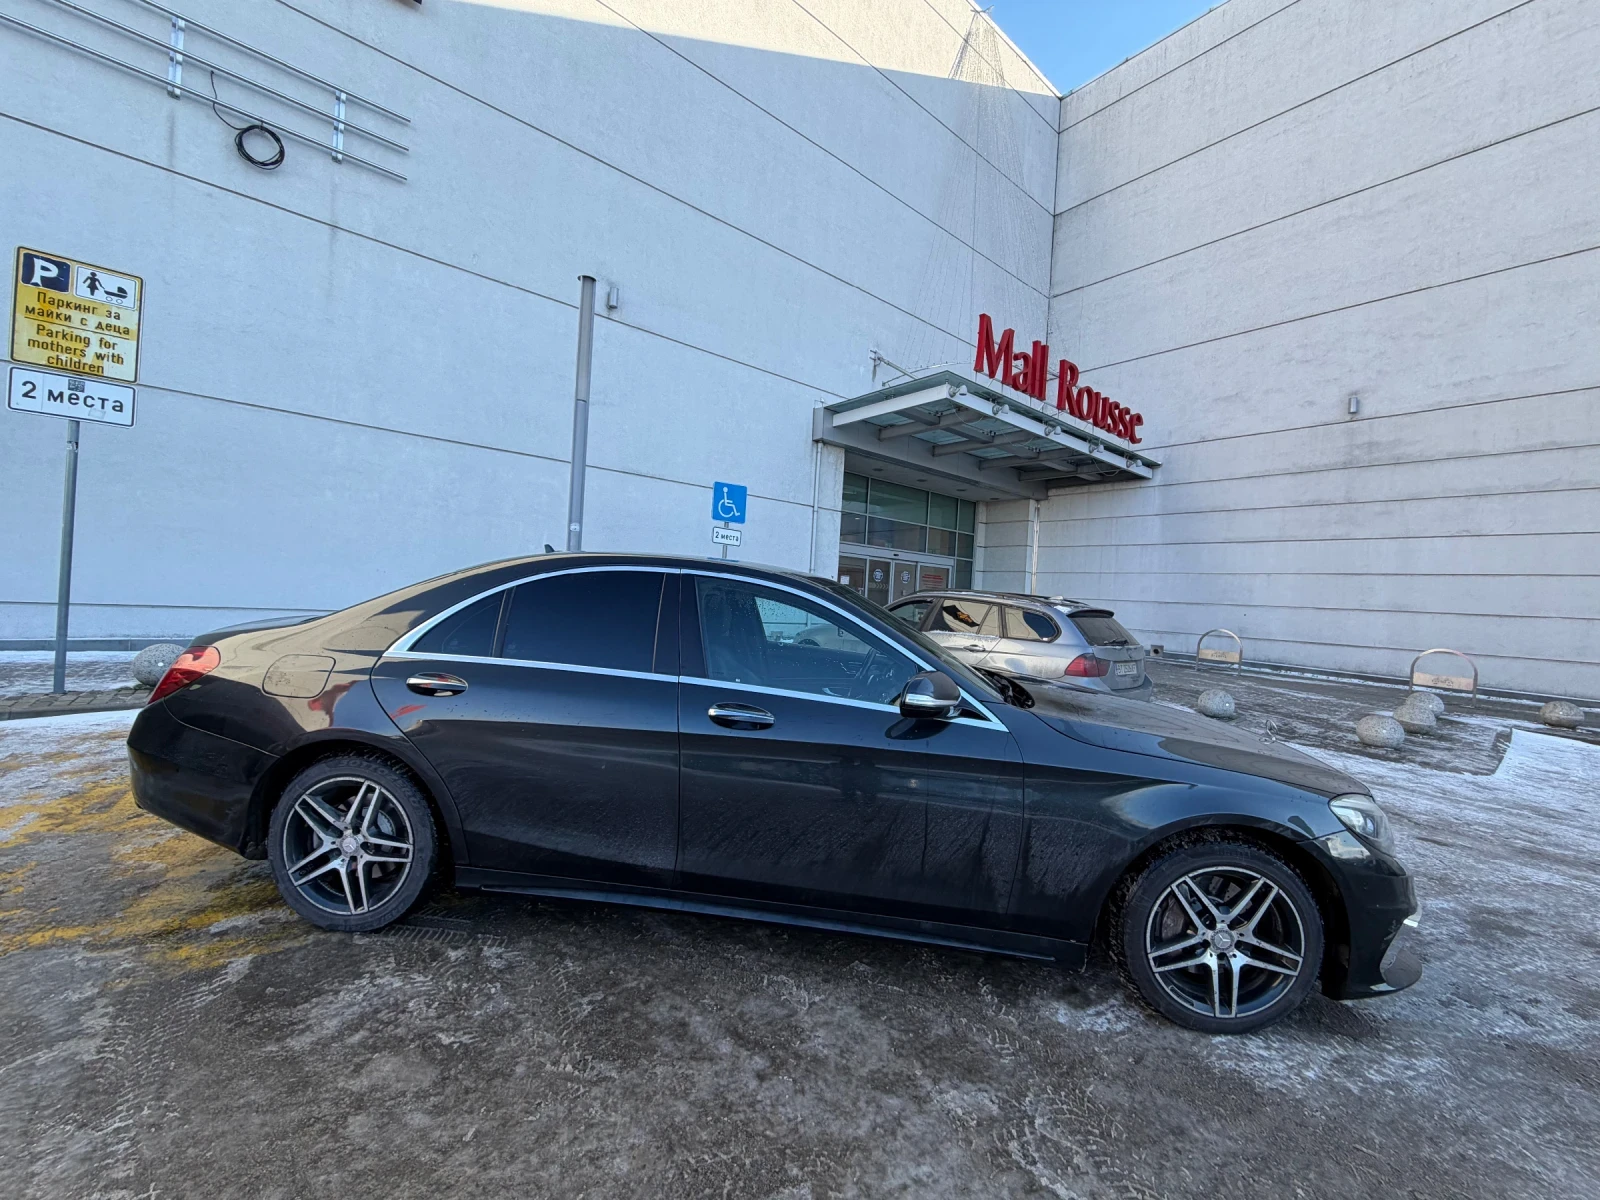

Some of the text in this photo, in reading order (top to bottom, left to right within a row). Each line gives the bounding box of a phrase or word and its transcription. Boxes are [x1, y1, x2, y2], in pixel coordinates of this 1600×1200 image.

[29, 257, 59, 287] P
[25, 304, 130, 336] майки с деца
[37, 291, 121, 321] Паркинг за
[27, 338, 124, 365] mothers with
[36, 323, 118, 351] Parking for
[47, 355, 104, 374] children
[973, 313, 1144, 444] Mall Rousse
[21, 380, 124, 412] 2 места
